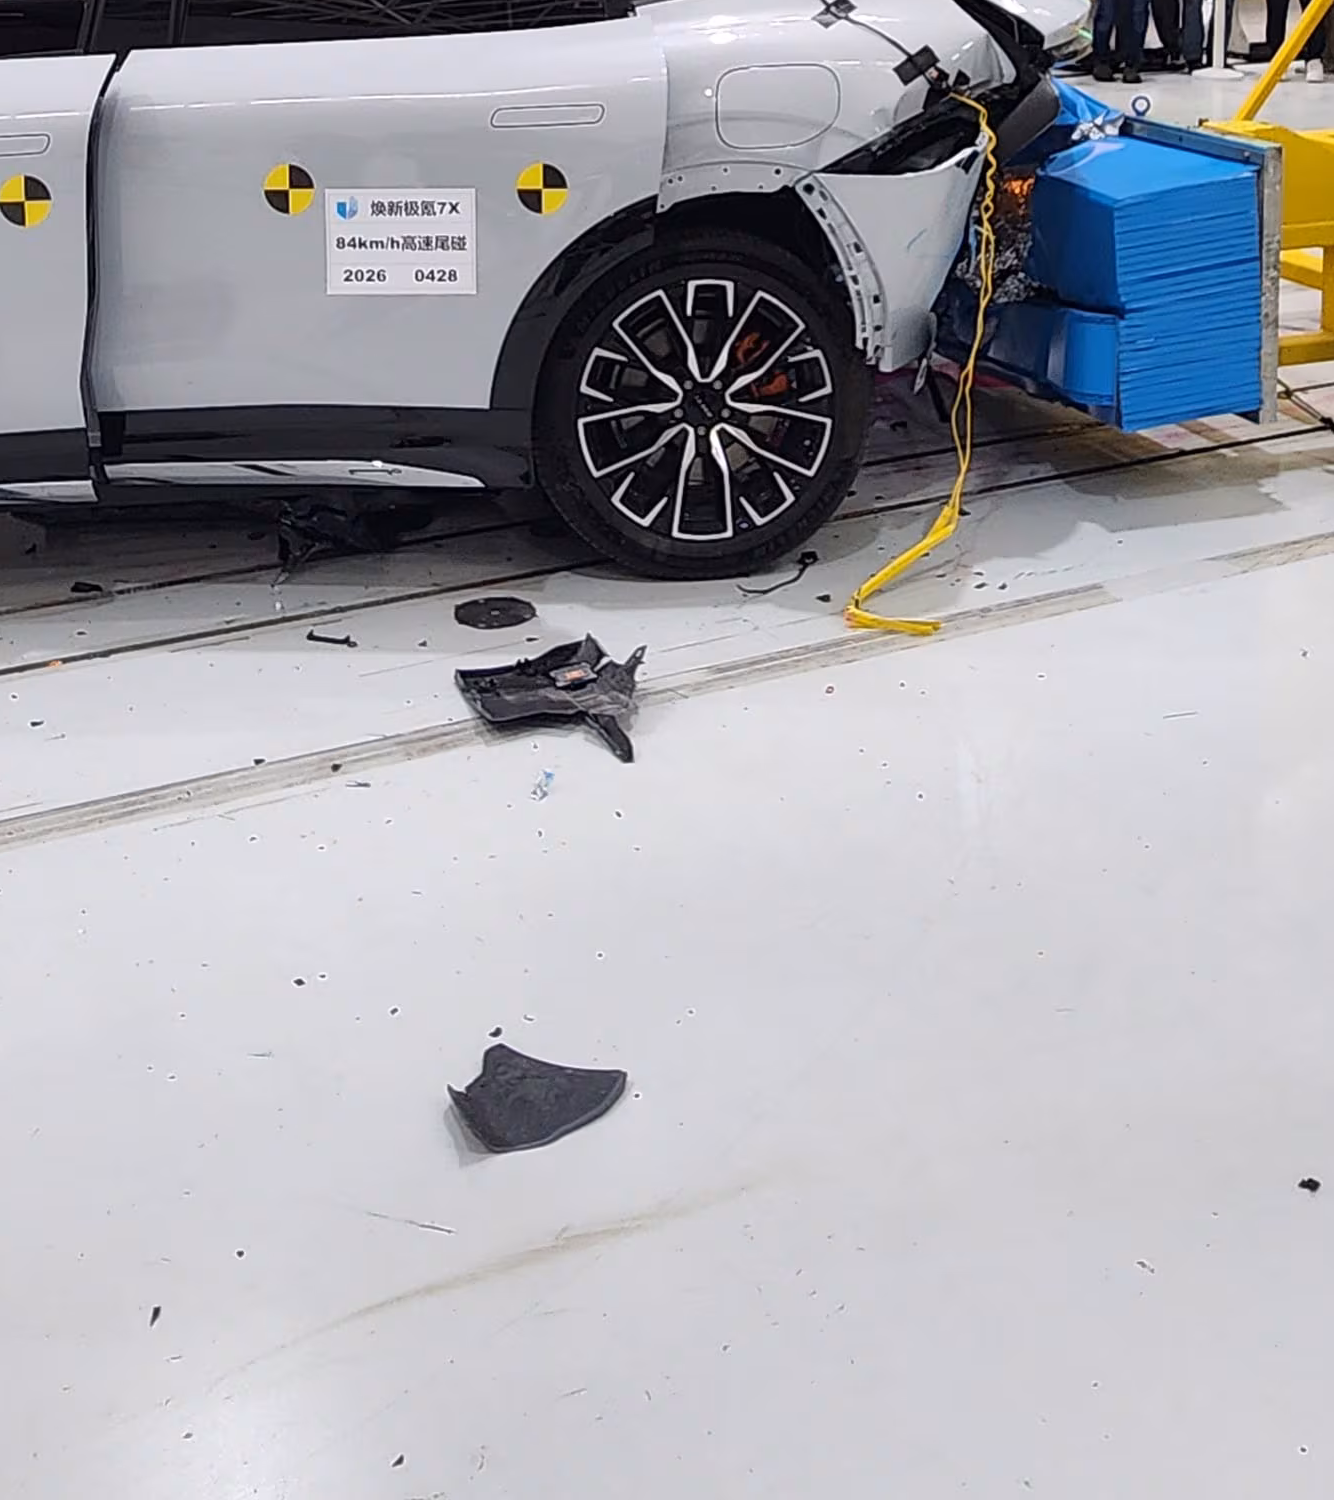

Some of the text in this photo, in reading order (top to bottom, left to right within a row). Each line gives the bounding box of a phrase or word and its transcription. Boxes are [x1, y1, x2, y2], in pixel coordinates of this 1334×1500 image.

[370, 200, 460, 217] 焕新极氪7X
[336, 235, 467, 251] 84km/h高速尾碰
[343, 269, 458, 282] 2026 0428
